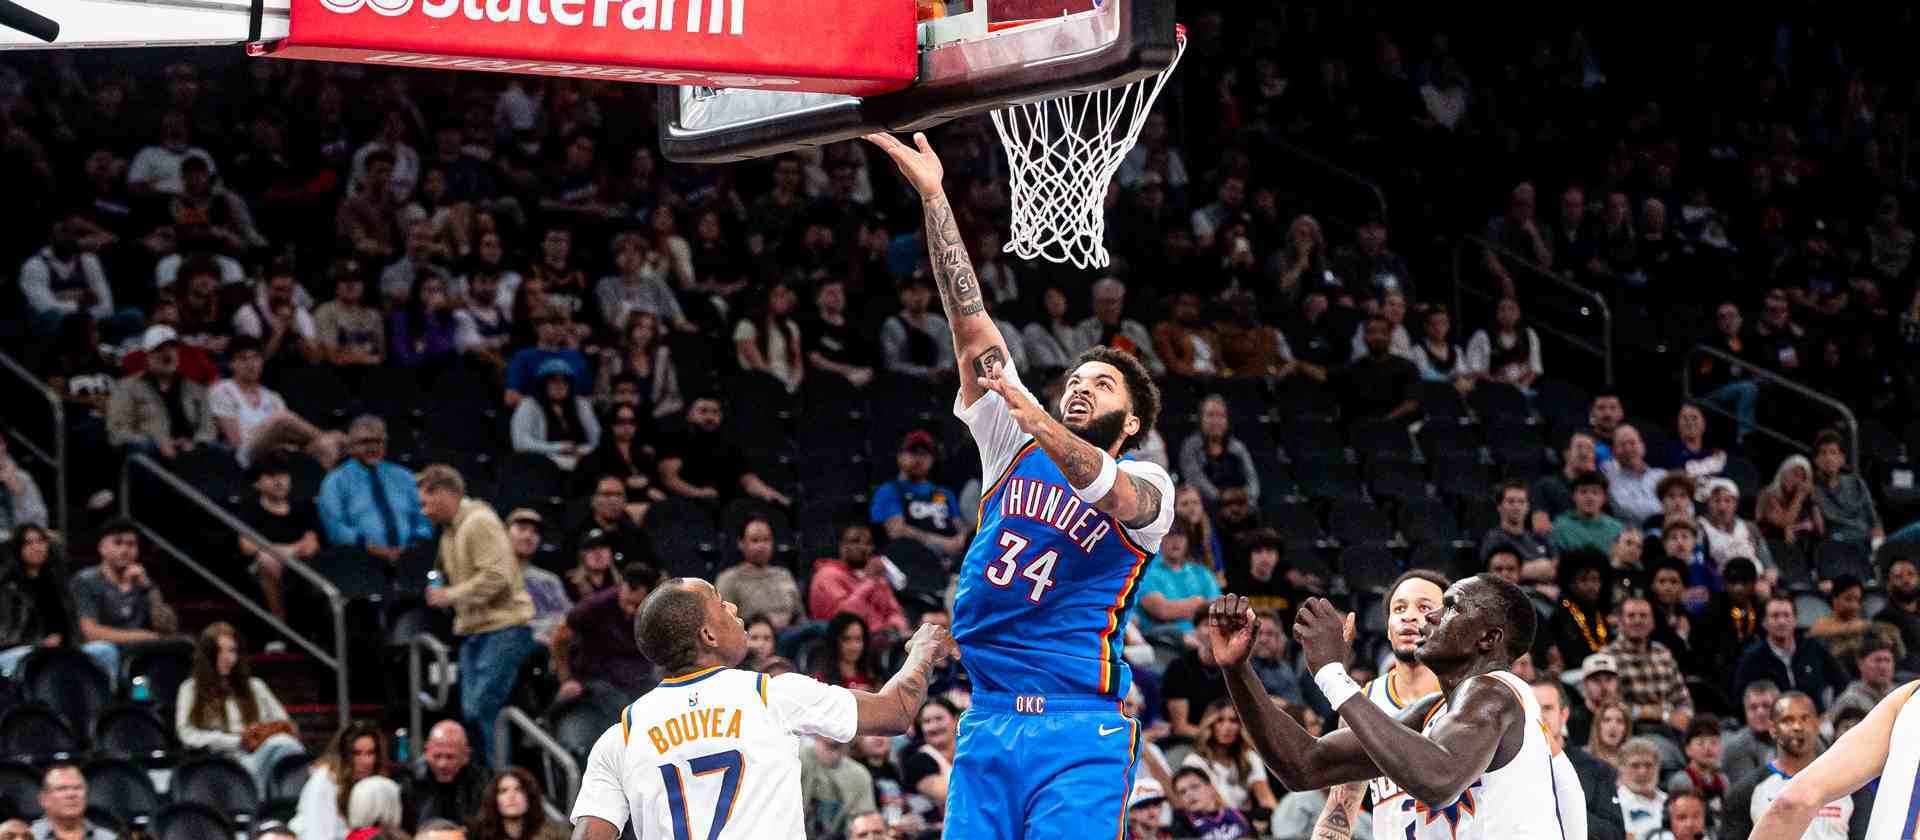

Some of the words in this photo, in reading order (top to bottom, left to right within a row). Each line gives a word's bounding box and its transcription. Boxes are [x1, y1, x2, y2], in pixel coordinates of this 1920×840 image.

[986, 530, 1059, 602] 34
[647, 707, 742, 754] BOUYEA
[1016, 696, 1044, 713] OKC
[657, 749, 746, 840] 17
